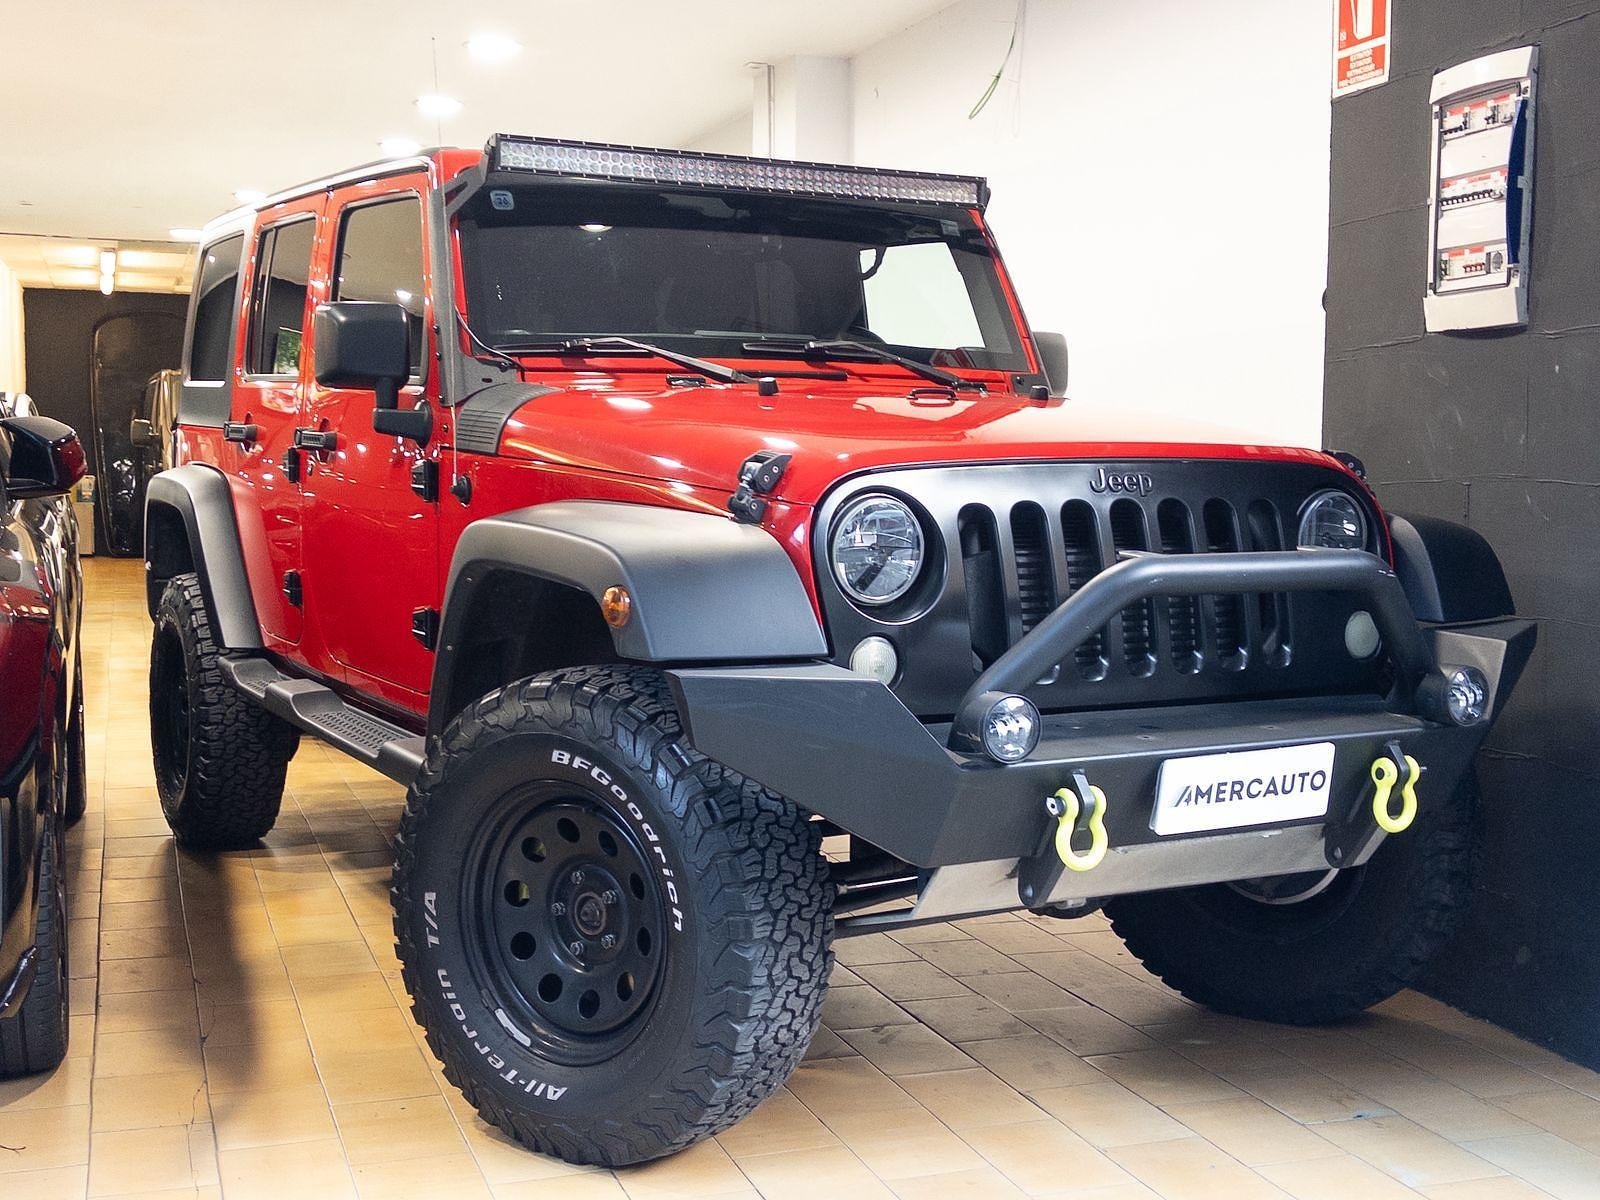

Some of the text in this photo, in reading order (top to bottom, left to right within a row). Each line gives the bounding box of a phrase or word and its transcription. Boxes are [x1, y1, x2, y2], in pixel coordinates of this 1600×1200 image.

[1090, 467, 1154, 497] Jeep
[550, 748, 685, 934] BFGoodrich
[1173, 769, 1327, 808] AMERCAUTO
[423, 891, 569, 1102] All-Terrain T/A
